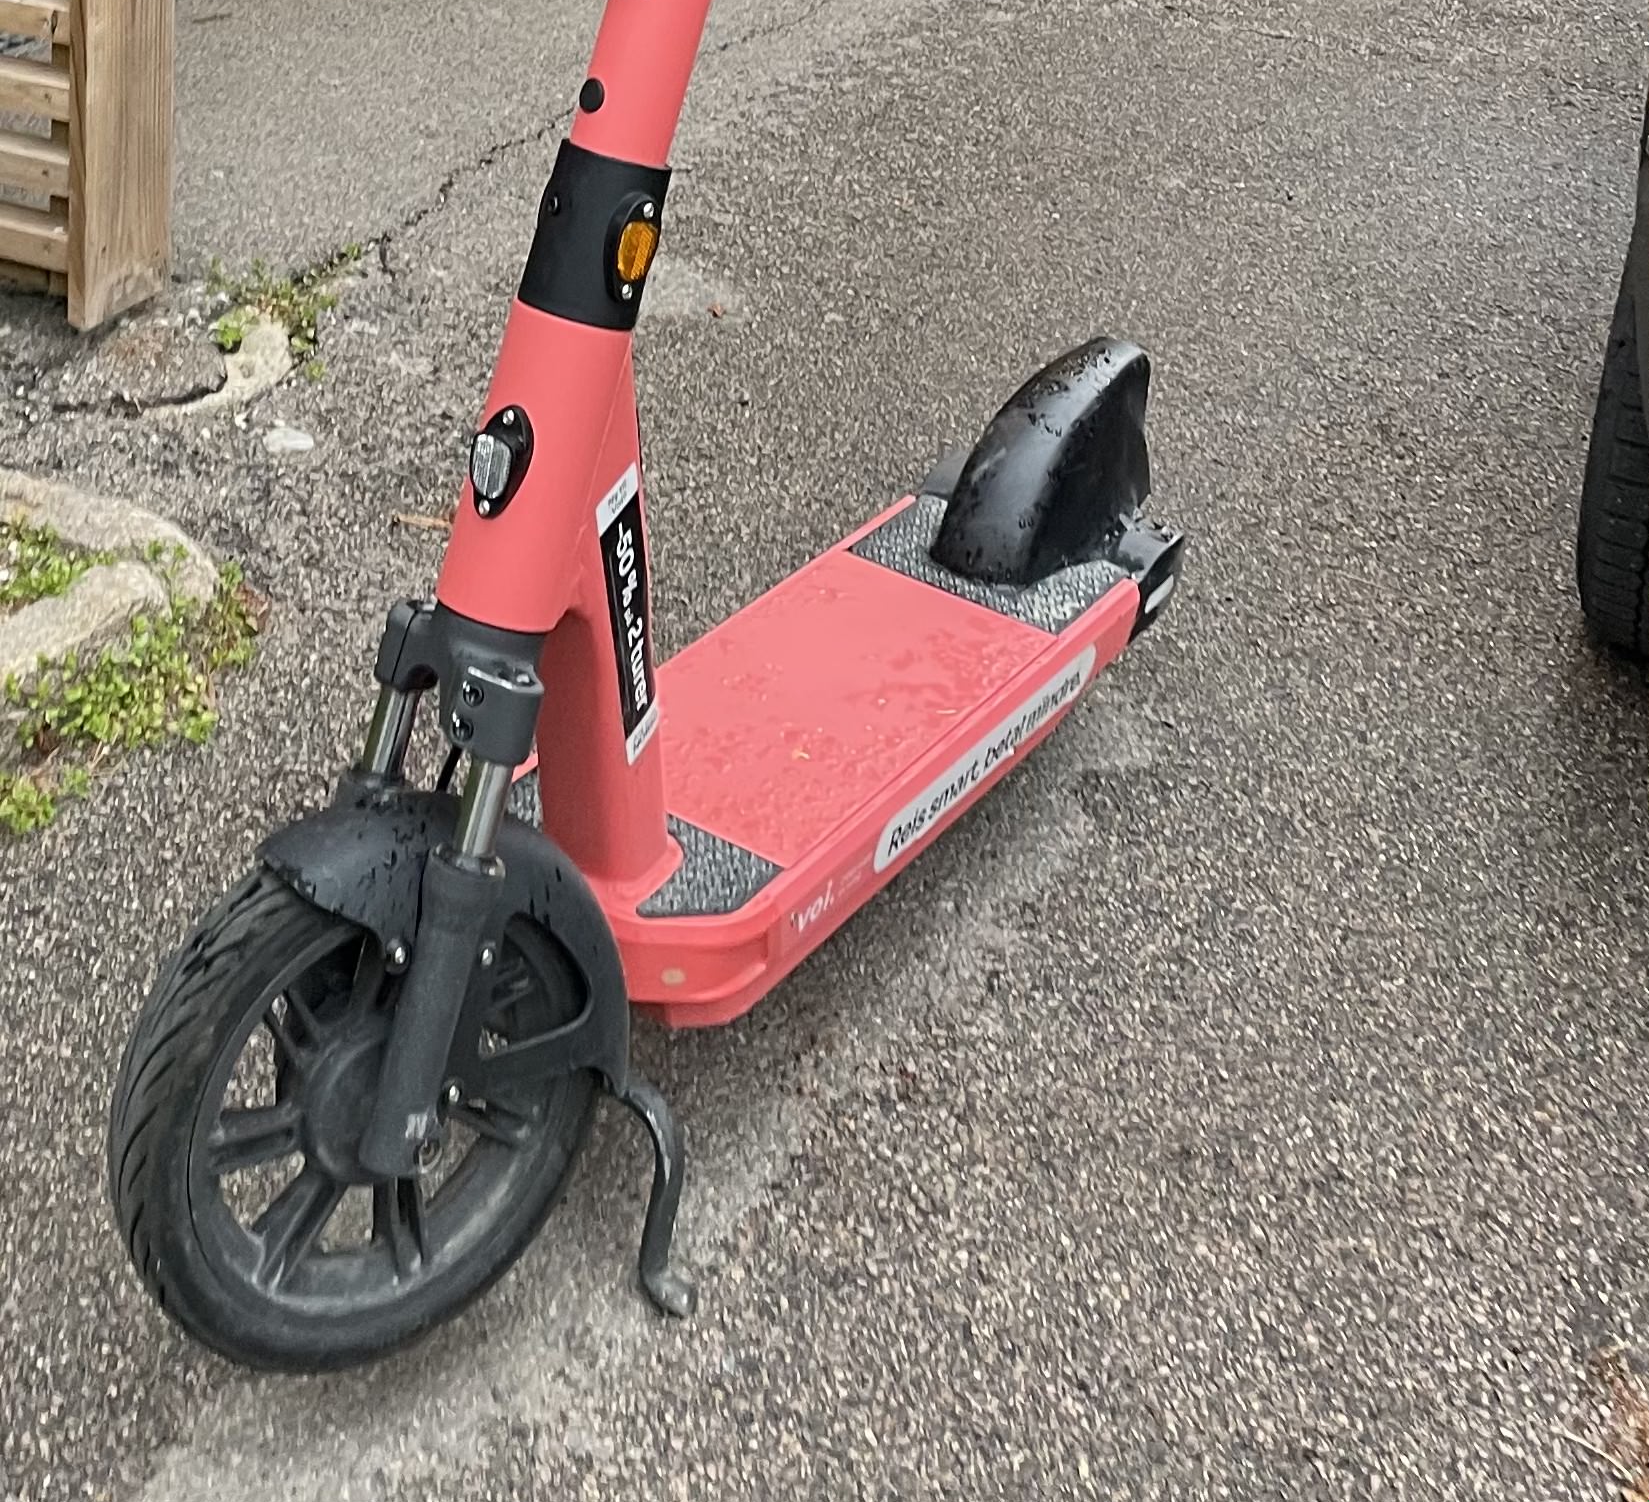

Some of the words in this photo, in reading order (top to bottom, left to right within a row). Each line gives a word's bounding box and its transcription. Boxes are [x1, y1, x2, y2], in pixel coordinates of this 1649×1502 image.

[616, 521, 635, 577] -50
[627, 617, 643, 647] 2
[630, 636, 649, 711] turer
[887, 806, 927, 857] Reis
